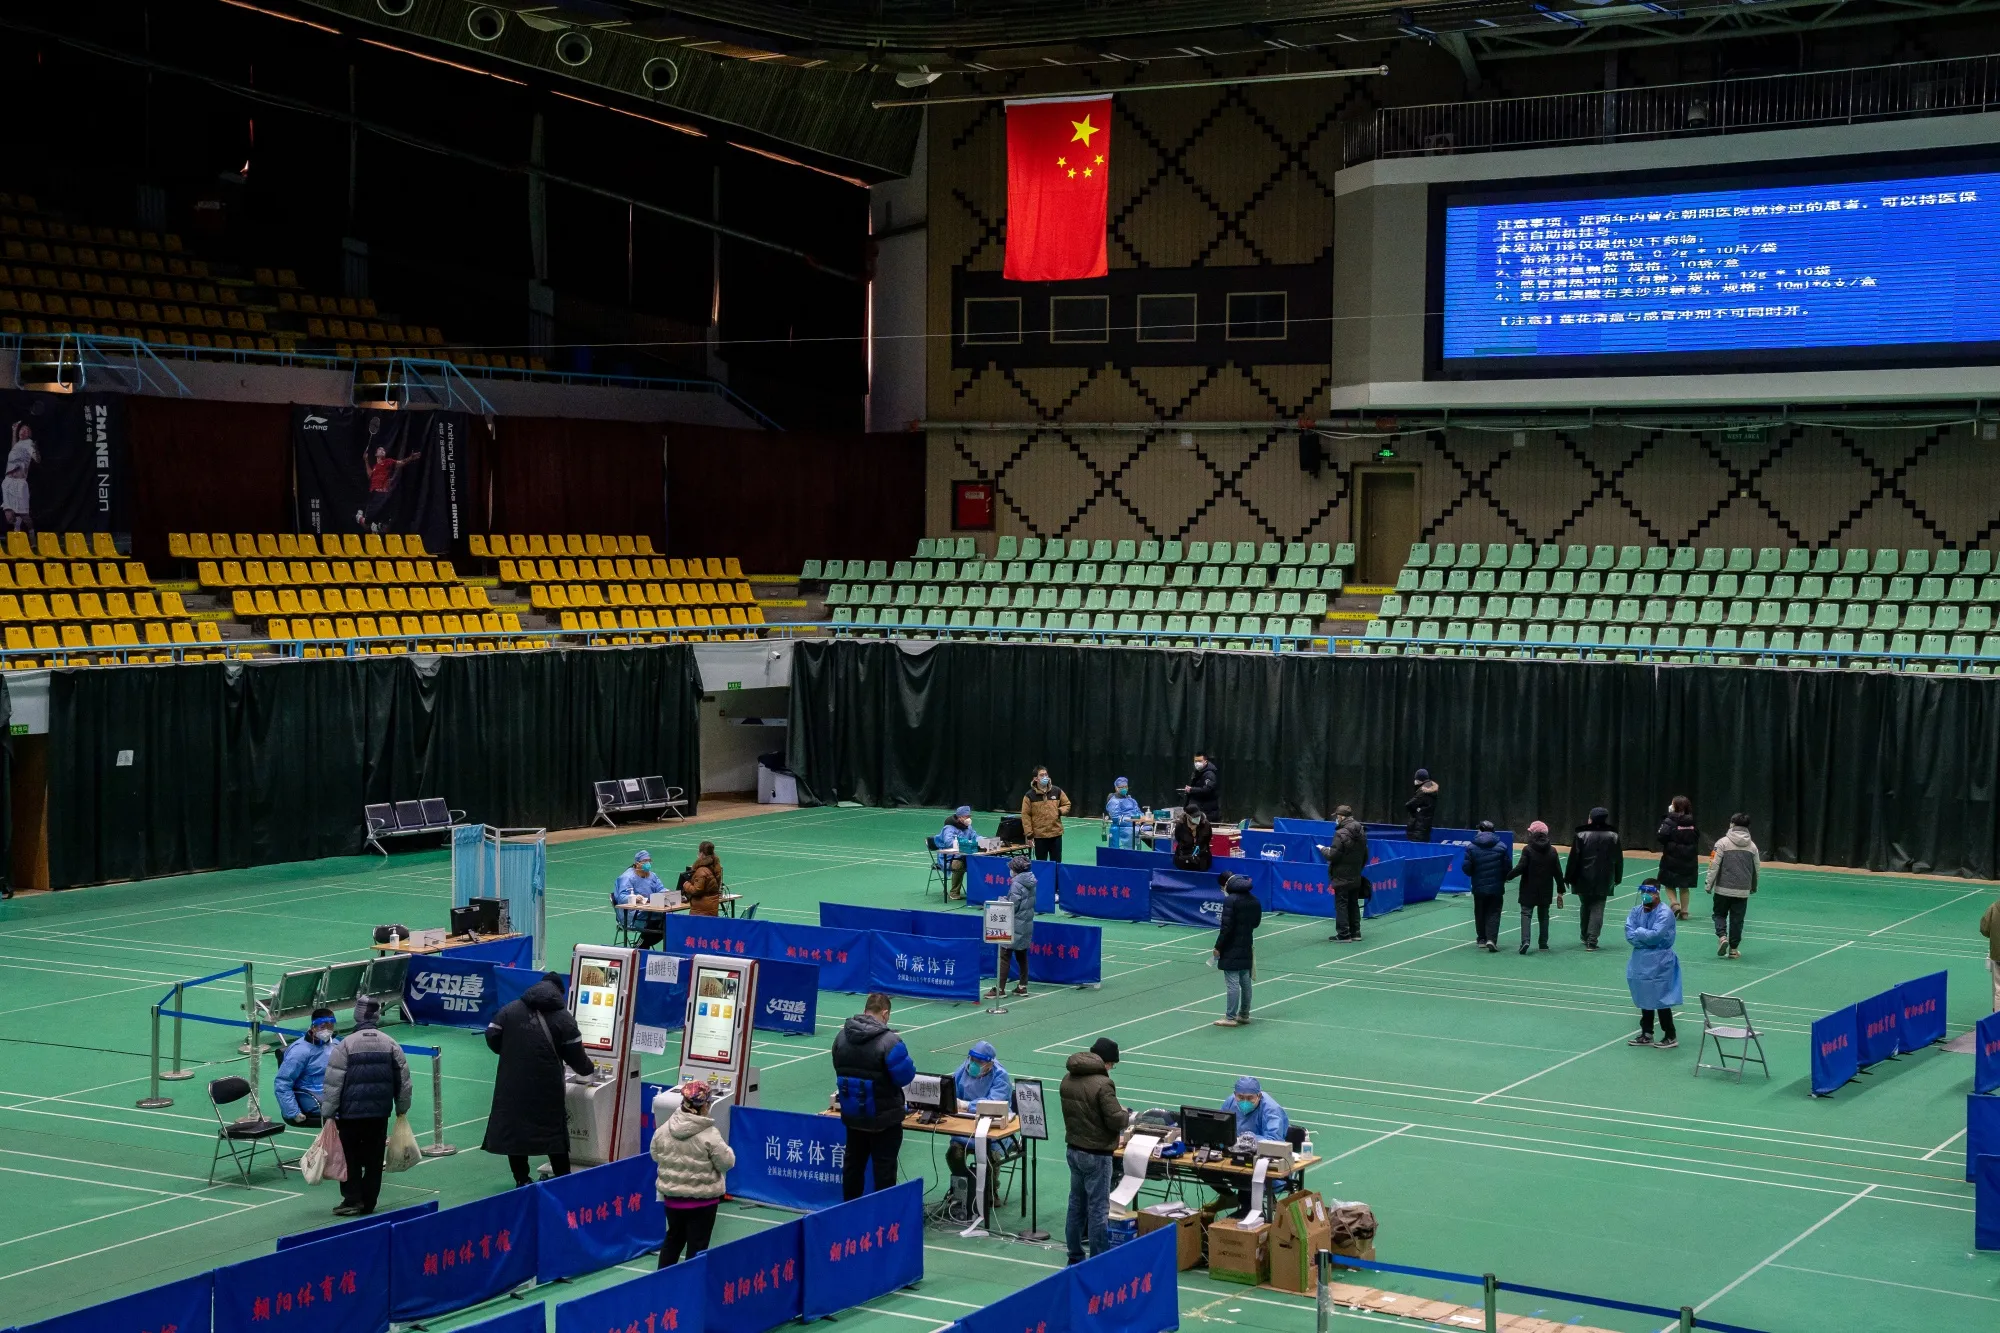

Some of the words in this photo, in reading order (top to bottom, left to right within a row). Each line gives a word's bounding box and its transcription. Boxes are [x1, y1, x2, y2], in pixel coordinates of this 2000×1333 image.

[95, 405, 109, 468] ZHANG
[97, 474, 110, 511] Nan
[451, 503, 459, 539] GINTING
[990, 913, 1007, 923] 诊室
[684, 935, 746, 953] 朝阳体育馆
[786, 946, 848, 964] 朝阳体育馆
[648, 961, 677, 977] 自助挂号处
[895, 953, 956, 976] 尚霖体育
[410, 971, 485, 1000] 红双喜
[441, 996, 482, 1012] DHS
[766, 998, 806, 1014] 红双喜
[782, 1012, 804, 1023] DHS
[635, 1030, 664, 1049] 自助挂号处
[1019, 1090, 1040, 1102] 挂号处
[1022, 1114, 1043, 1126] 收费处
[766, 1135, 847, 1168] 尚霖体育
[567, 1192, 642, 1229] 朝阳体育馆
[422, 1229, 511, 1276] 朝阳体育馆
[829, 1222, 900, 1262] 朝阳体育馆
[722, 1257, 795, 1305] 朝阳体育馆
[252, 1269, 357, 1321] 朝阳体育馆
